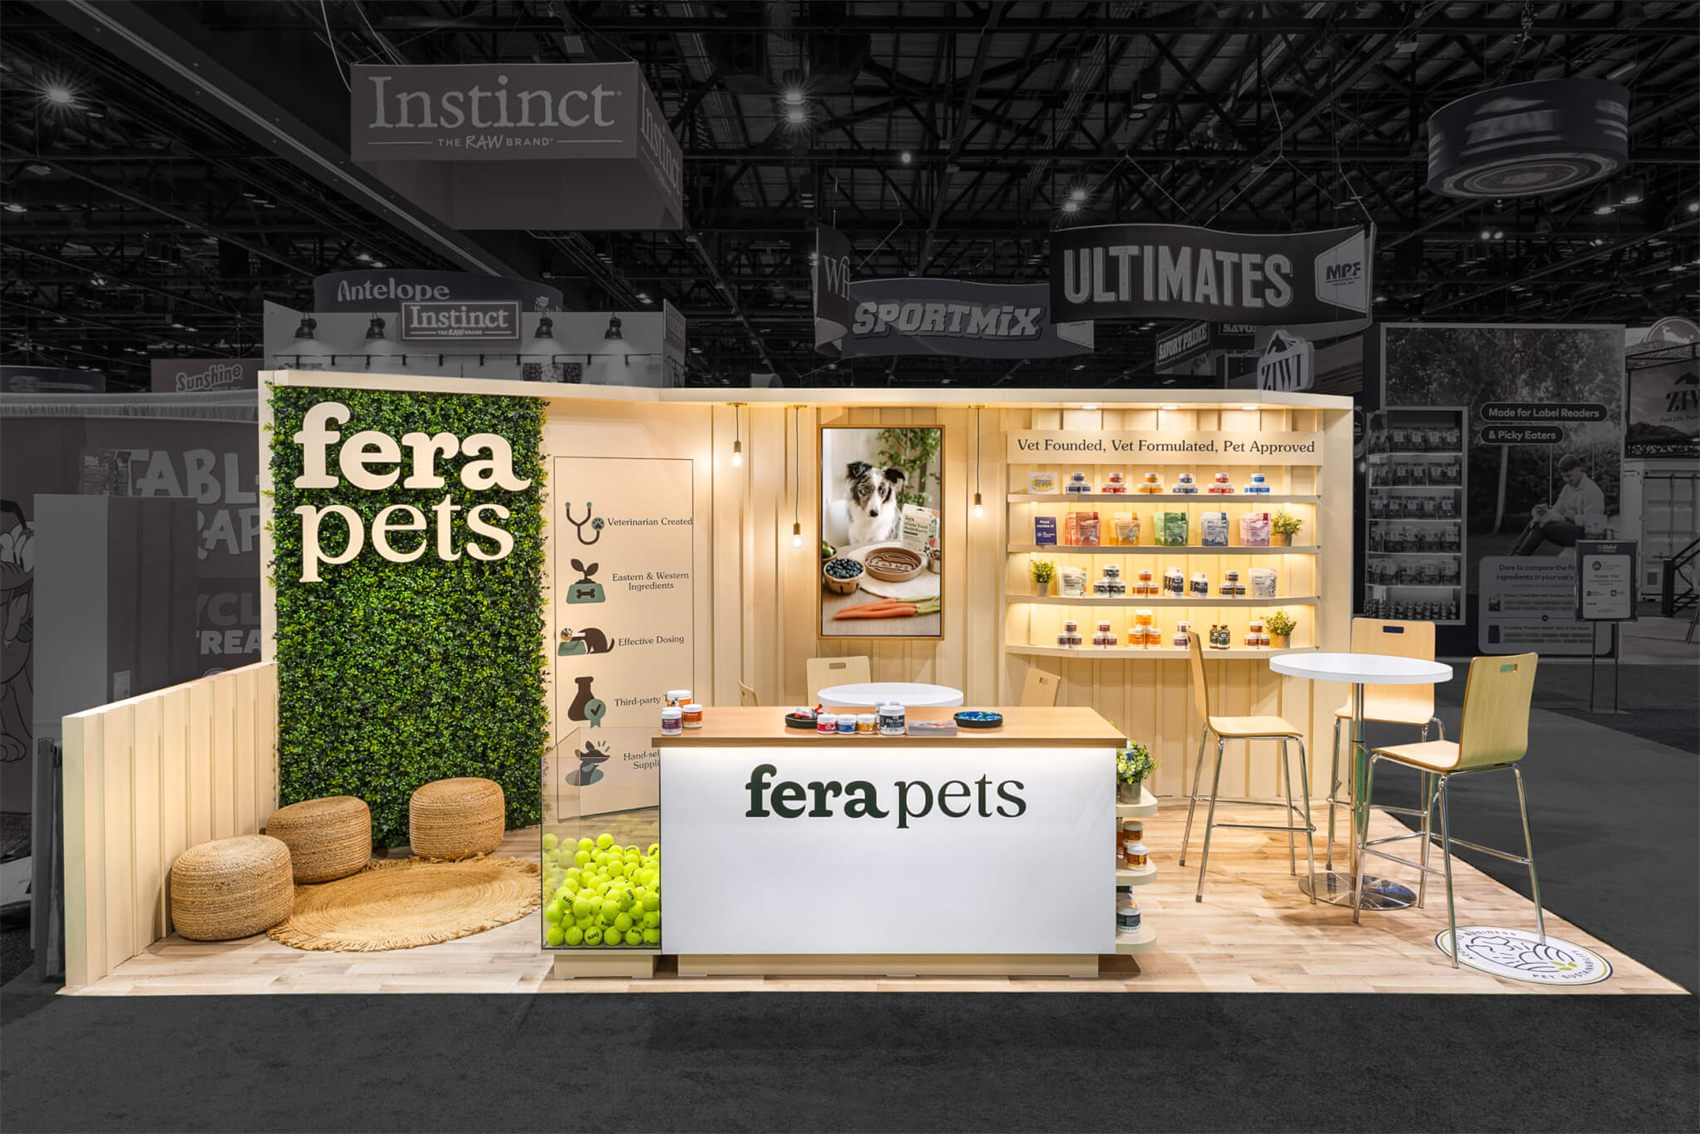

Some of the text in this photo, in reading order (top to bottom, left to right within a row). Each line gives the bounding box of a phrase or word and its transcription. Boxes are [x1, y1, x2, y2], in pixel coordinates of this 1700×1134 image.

[368, 75, 616, 129] Instinct
[437, 138, 461, 147] THE
[465, 134, 504, 150] RAW
[1063, 245, 1294, 308] ULTIMATES
[337, 278, 451, 302] Antelope
[409, 306, 513, 328] Instinct
[1222, 323, 1256, 333] SAVO
[176, 364, 243, 393] Sunshine
[1488, 408, 1600, 418] Made for Label Readers
[1488, 430, 1557, 441] & Picky Eaters
[294, 401, 532, 491] fera
[1018, 439, 1315, 455] Vet Founded, Vet Formulated, Pet Approved
[607, 517, 693, 526] Veterinarian Created
[294, 494, 514, 583] pets
[612, 571, 689, 582] Eastern & Western
[628, 582, 674, 592] Ingredients
[618, 635, 685, 646] Effective Dosing
[614, 697, 661, 708] Third-party
[745, 763, 1027, 829] fera pets
